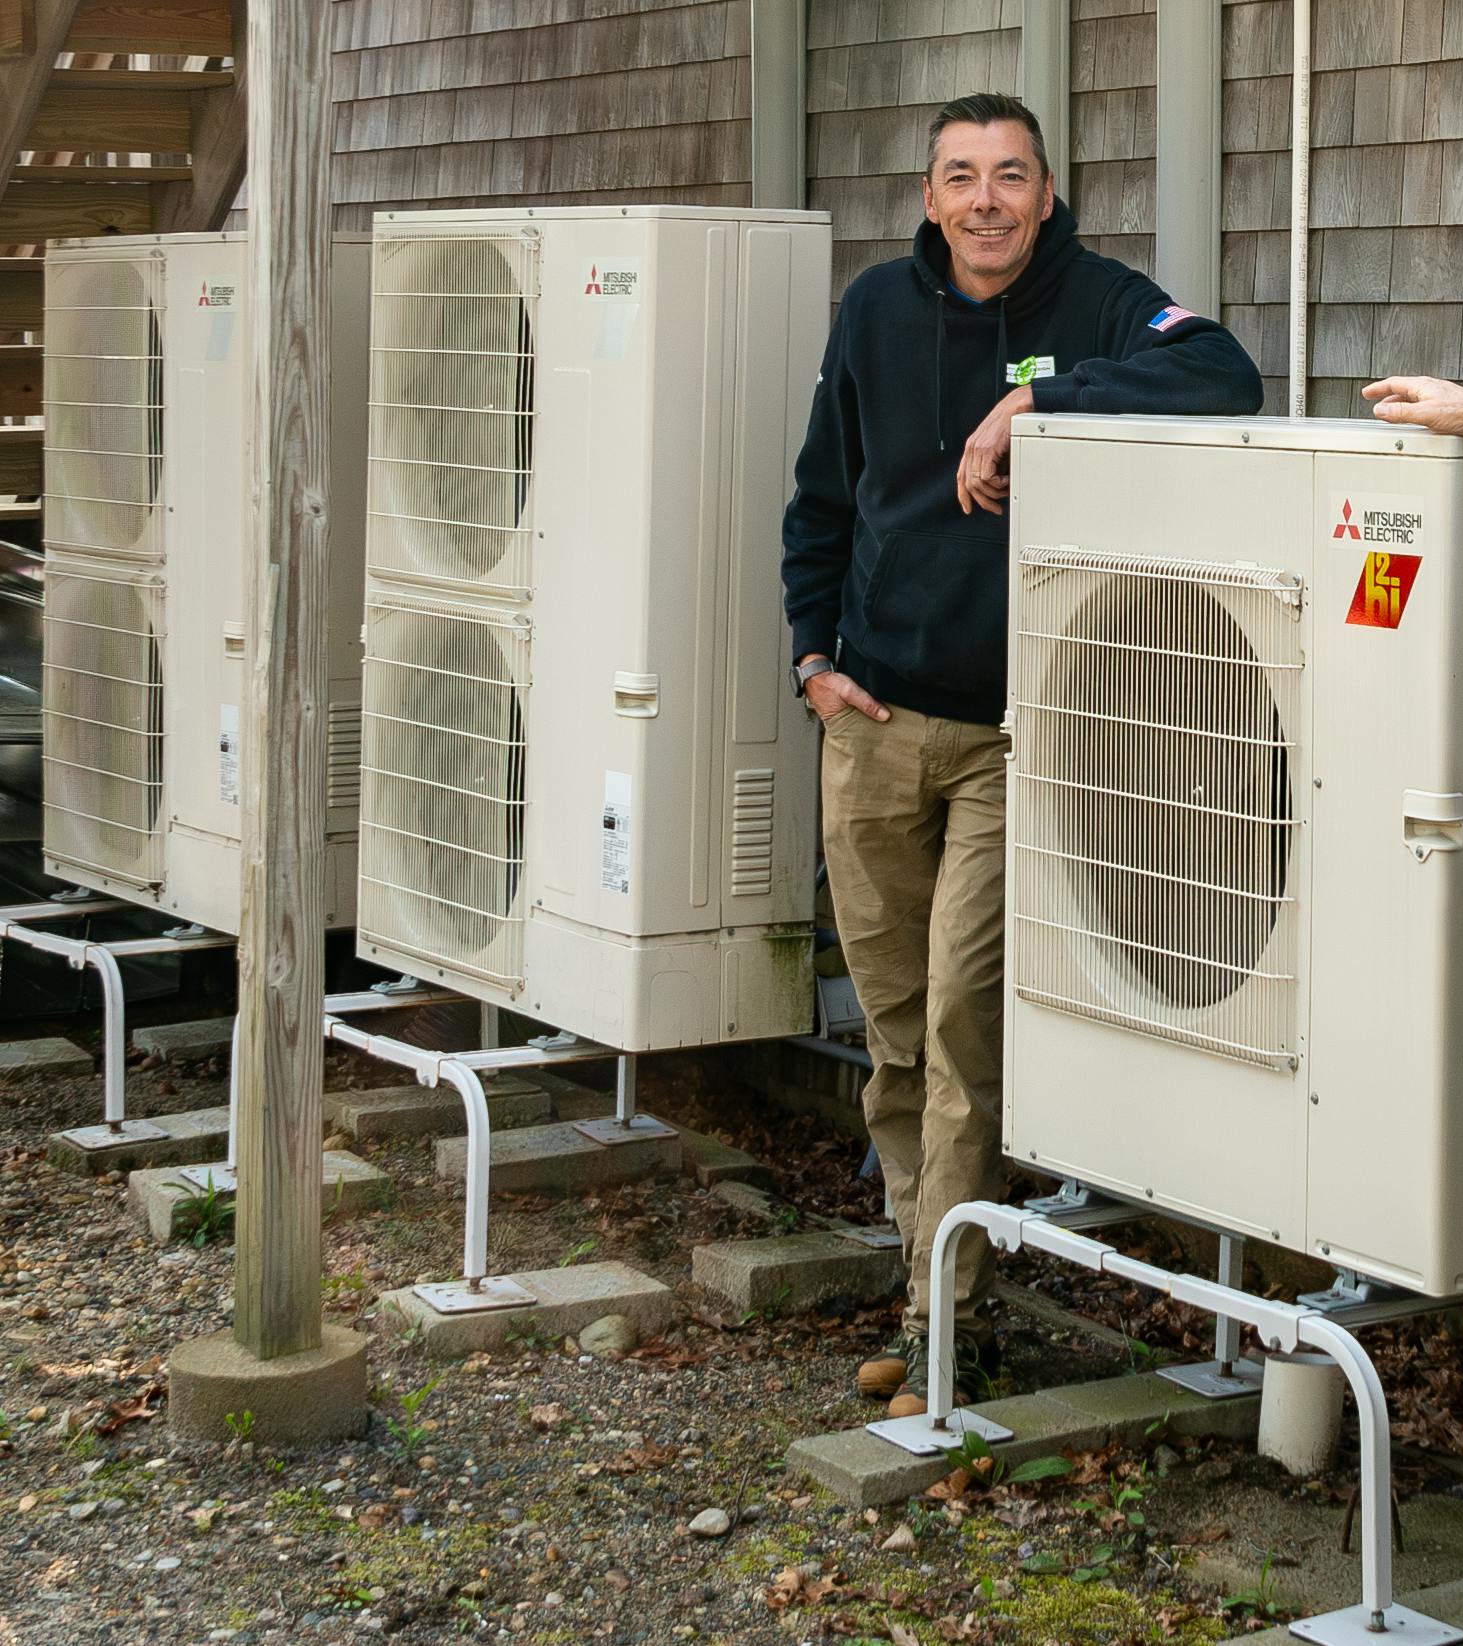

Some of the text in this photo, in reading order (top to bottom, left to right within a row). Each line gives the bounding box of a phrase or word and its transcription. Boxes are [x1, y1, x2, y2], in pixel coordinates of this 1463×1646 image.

[603, 271, 638, 283] MITSUBISHI
[602, 284, 632, 295] ELECTRIC
[1363, 511, 1422, 529] MITSUBISHI
[1363, 527, 1414, 544] ELECTRIC
